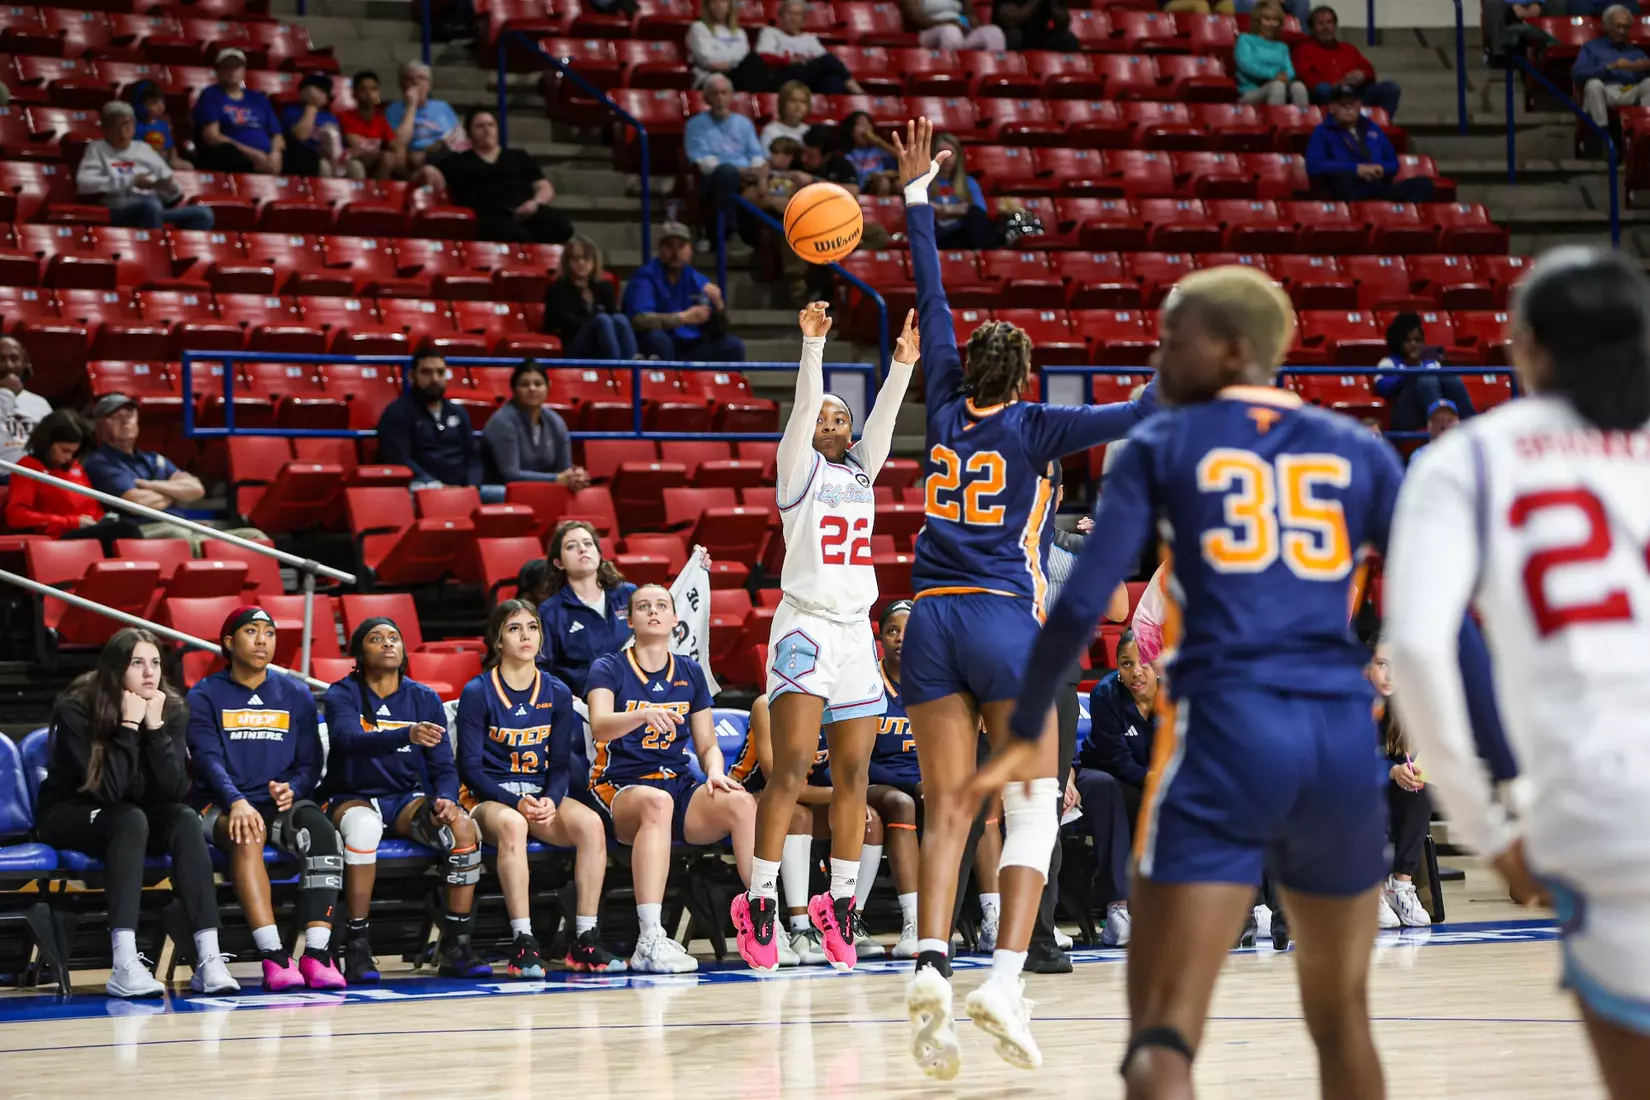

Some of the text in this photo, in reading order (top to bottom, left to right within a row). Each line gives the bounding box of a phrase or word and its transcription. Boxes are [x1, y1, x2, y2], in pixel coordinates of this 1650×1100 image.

[813, 227, 860, 253] Wilson
[925, 443, 1006, 525] 22
[1196, 447, 1353, 582] 35
[819, 515, 873, 566] 22
[238, 712, 277, 725] UTEP
[488, 725, 552, 747] UTEP
[510, 751, 539, 774] 12
